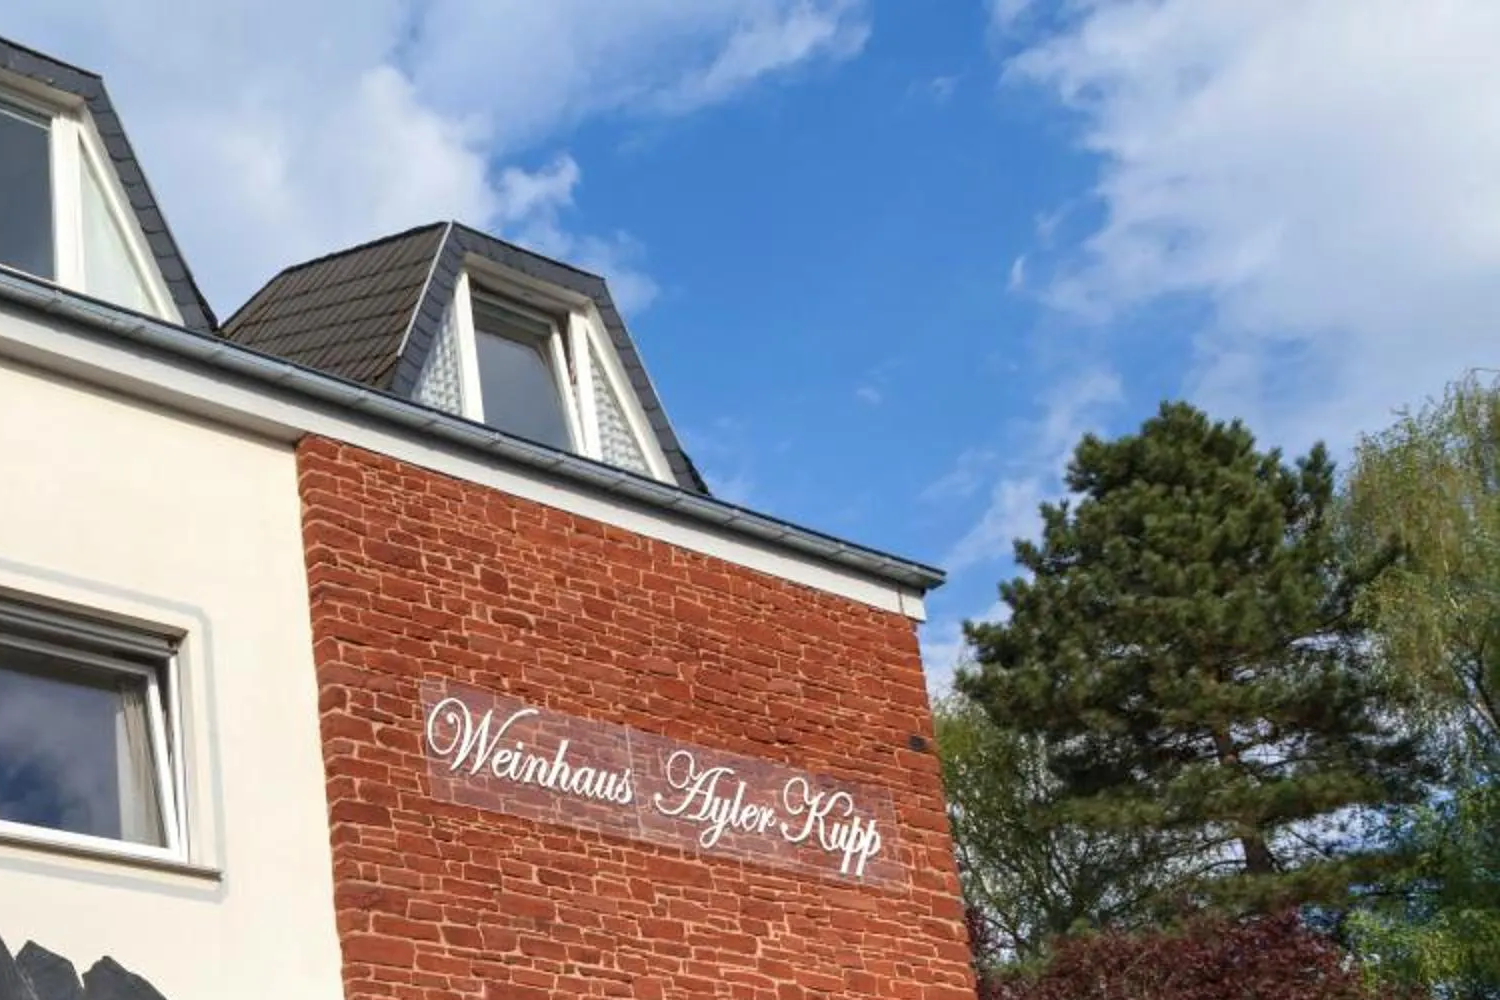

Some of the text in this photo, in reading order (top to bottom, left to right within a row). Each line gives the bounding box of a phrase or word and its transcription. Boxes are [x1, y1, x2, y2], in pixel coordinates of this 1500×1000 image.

[427, 697, 881, 877] Weinhaus Ayler Kupp
